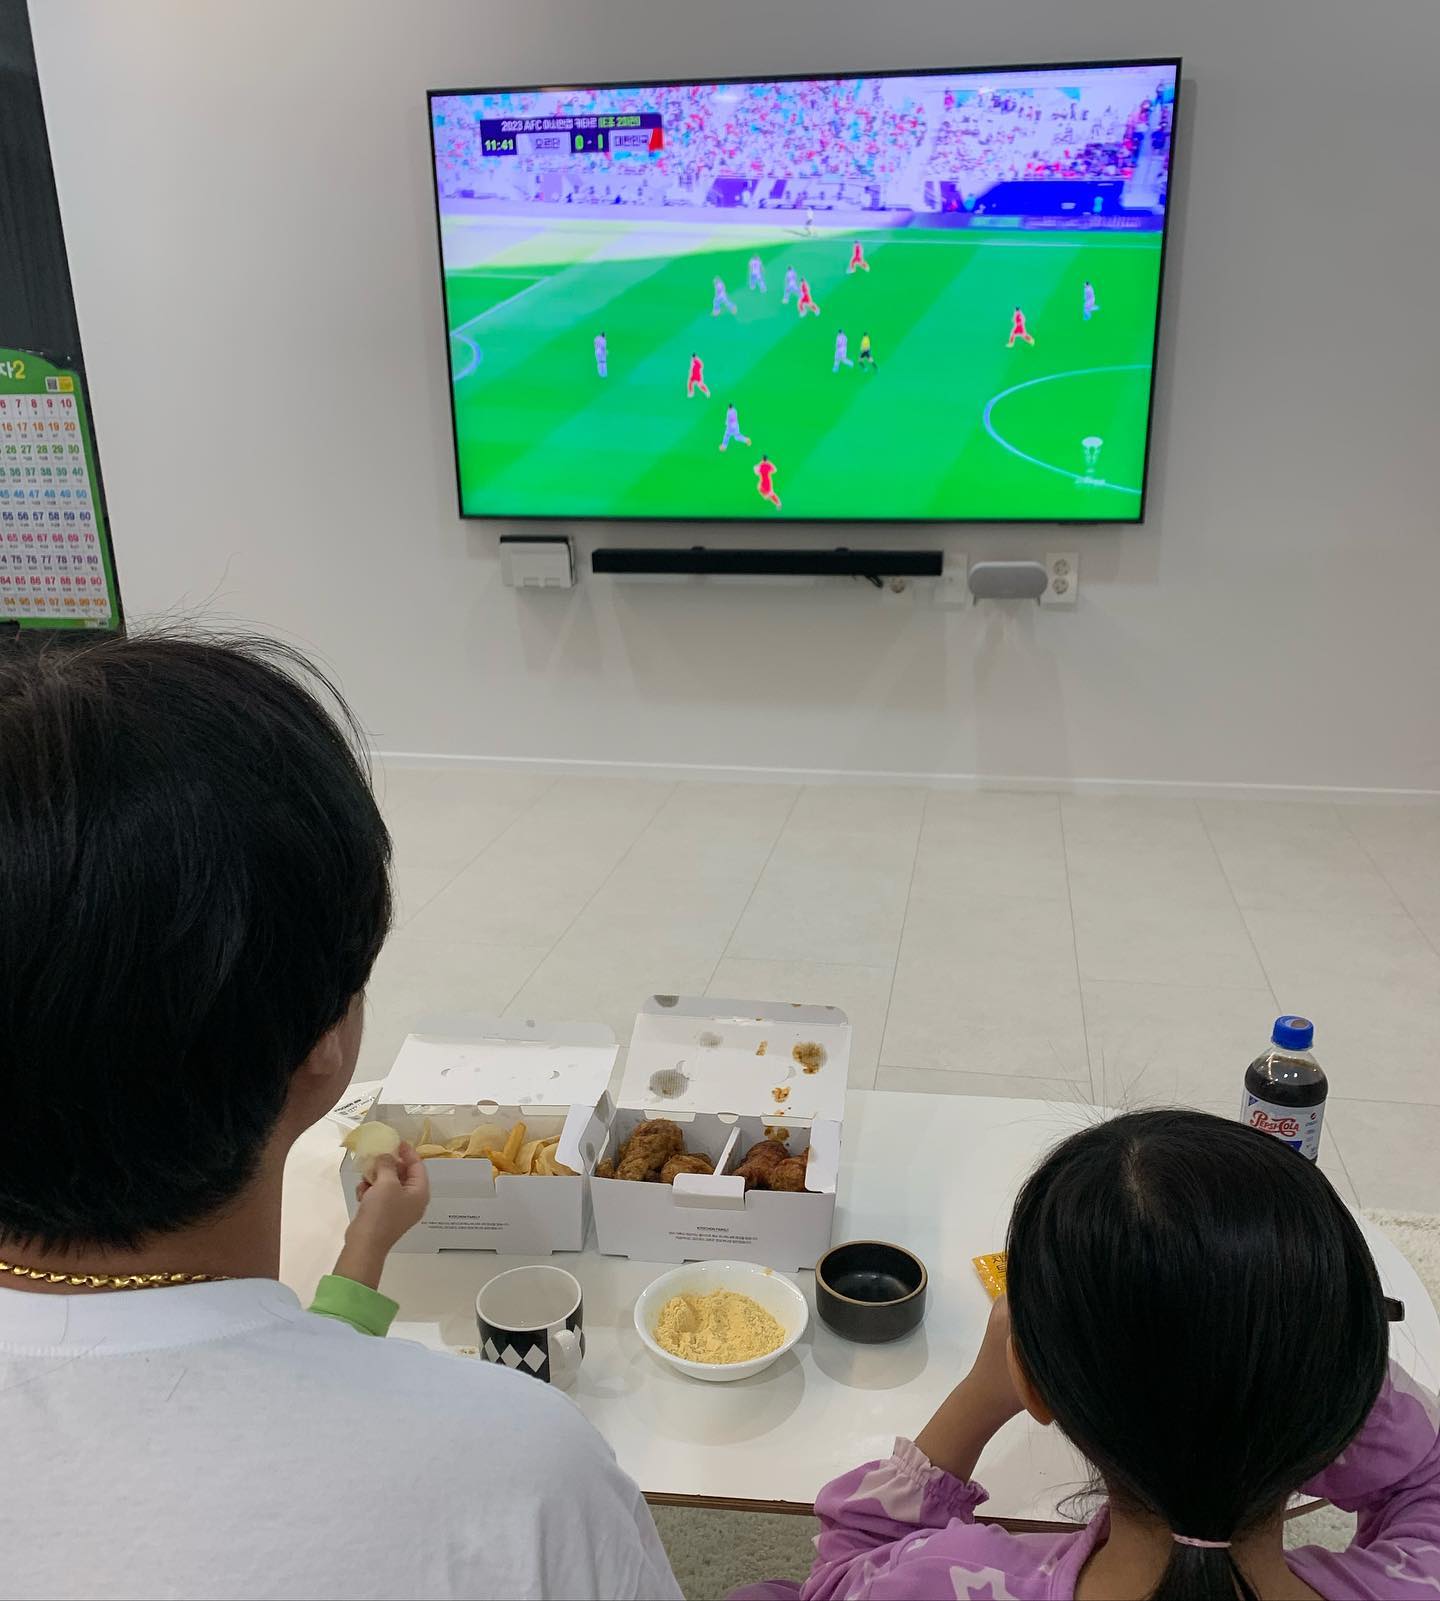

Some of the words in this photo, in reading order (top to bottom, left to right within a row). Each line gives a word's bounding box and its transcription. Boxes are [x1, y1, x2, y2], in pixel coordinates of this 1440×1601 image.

[501, 120, 524, 132] 2023
[524, 119, 543, 132] AFC
[484, 138, 514, 151] 11:41
[574, 134, 584, 150] 0
[15, 399, 21, 408] 7
[31, 399, 37, 408] 8
[46, 399, 53, 408] 9
[61, 399, 72, 408] 10
[2, 422, 13, 431] 16
[17, 422, 27, 431] 17
[33, 422, 44, 431] 18
[48, 422, 60, 431] 19
[64, 422, 76, 431] 20
[5, 444, 17, 454] 26
[20, 444, 32, 454] 27
[36, 444, 48, 454] 28
[52, 444, 64, 454] 29
[68, 444, 79, 454] 30
[10, 467, 21, 477] 36
[25, 467, 36, 477] 37
[40, 467, 52, 477] 38
[56, 467, 67, 477] 39
[72, 467, 83, 477] 40
[14, 489, 25, 498] 46
[28, 489, 39, 498] 47
[44, 489, 56, 498] 48
[60, 489, 71, 498] 49
[76, 489, 87, 498] 50
[2, 511, 14, 521] 55
[17, 511, 29, 521] 56
[32, 511, 44, 521] 57
[48, 511, 60, 521] 58
[63, 511, 75, 521] 59
[79, 511, 91, 521] 60
[7, 533, 18, 543] 65
[22, 533, 33, 543] 66
[37, 533, 48, 543] 67
[52, 533, 64, 543] 68
[67, 533, 79, 543] 69
[84, 533, 95, 543] 70
[10, 555, 22, 564] 75
[26, 555, 37, 564] 76
[41, 555, 52, 564] 77
[55, 555, 67, 564] 78
[71, 555, 82, 564] 79
[86, 555, 98, 564] 80
[15, 576, 26, 585] 85
[30, 576, 41, 585] 86
[44, 576, 56, 585] 87
[60, 576, 71, 585] 88
[75, 576, 86, 585] 89
[90, 576, 102, 585] 90
